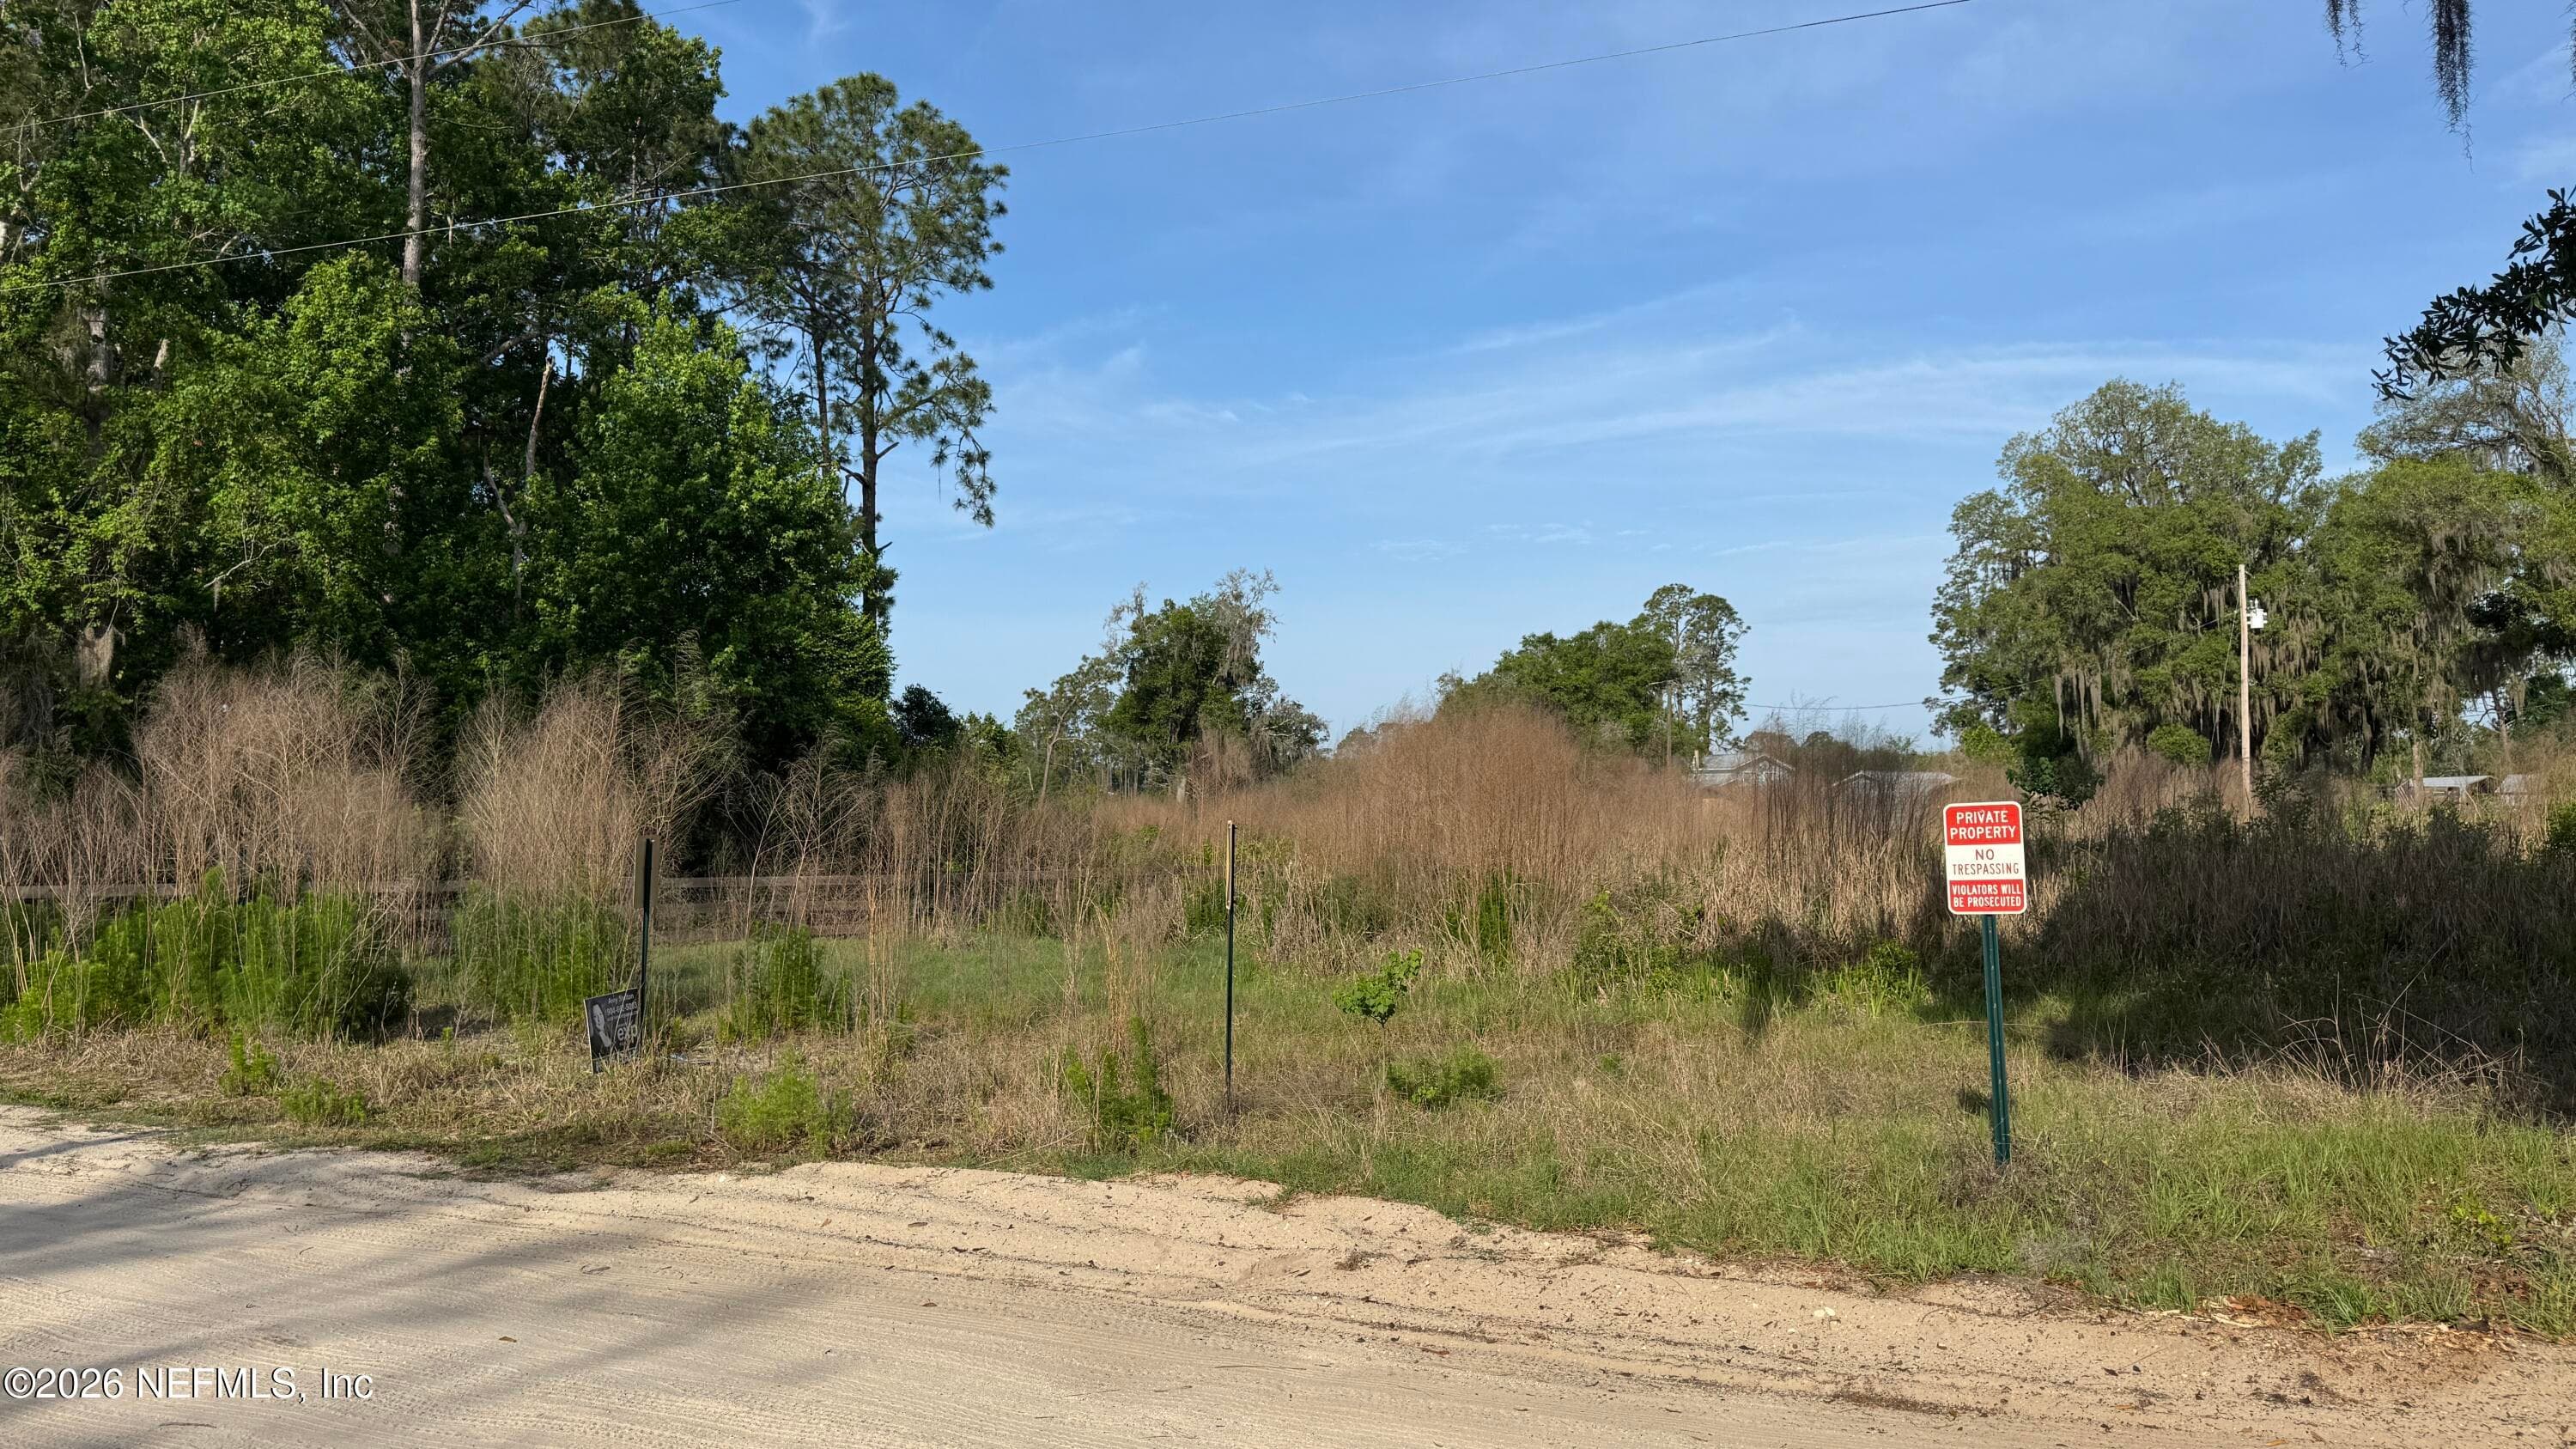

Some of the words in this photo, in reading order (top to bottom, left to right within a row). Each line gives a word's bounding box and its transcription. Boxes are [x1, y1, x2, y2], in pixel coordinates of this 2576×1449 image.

[1956, 809, 2008, 824] PRIVATE
[1950, 825, 2016, 840] PROPERTY
[1975, 849, 1995, 861] NO
[1953, 863, 2020, 875] TRESPASSING
[1952, 885, 1998, 896] VIOLATORS
[2001, 884, 2021, 895] WILL
[1953, 897, 1964, 908] BE
[1967, 896, 2021, 908] PROSECUTED
